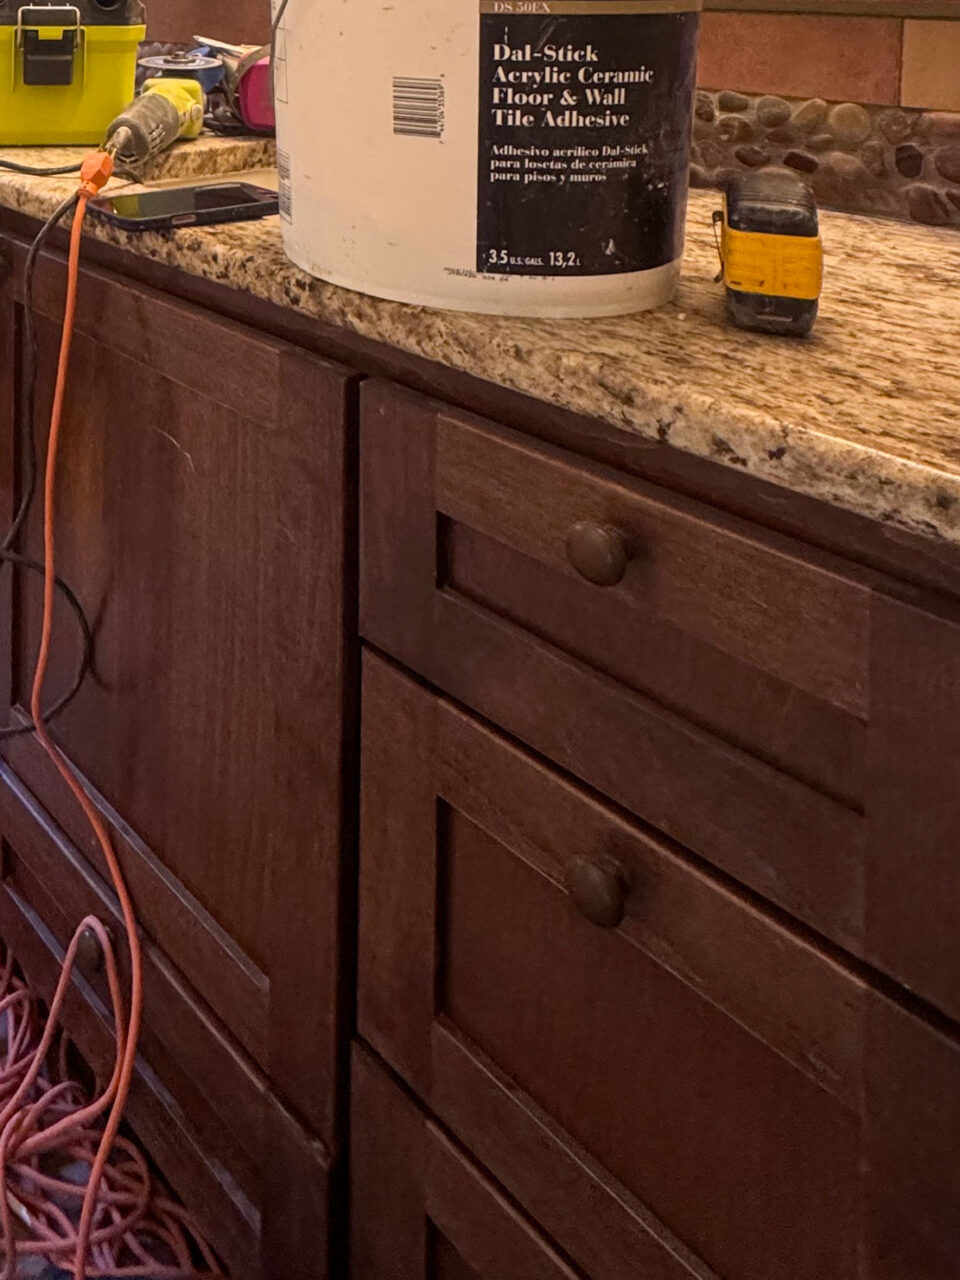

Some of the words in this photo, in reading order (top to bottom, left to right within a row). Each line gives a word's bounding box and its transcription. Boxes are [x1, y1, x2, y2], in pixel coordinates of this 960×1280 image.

[494, 2, 513, 13] DS
[493, 44, 598, 62] Dal-Stick
[492, 66, 572, 88] Acrylic
[578, 66, 654, 84] Ceramic
[492, 87, 554, 106] Floor
[560, 89, 578, 106] &
[585, 87, 626, 106] Wall
[491, 109, 535, 126] Tile
[541, 109, 630, 128] Adhesive
[491, 144, 549, 156] Adhesivo
[602, 143, 649, 157] Dal-Stick
[490, 159, 520, 170] para
[524, 158, 568, 169] losetas
[570, 158, 586, 169] de
[490, 172, 520, 183] para
[524, 171, 557, 184] pisos
[559, 173, 567, 185] y
[569, 173, 607, 182] muros
[549, 251, 576, 269] 13,2
